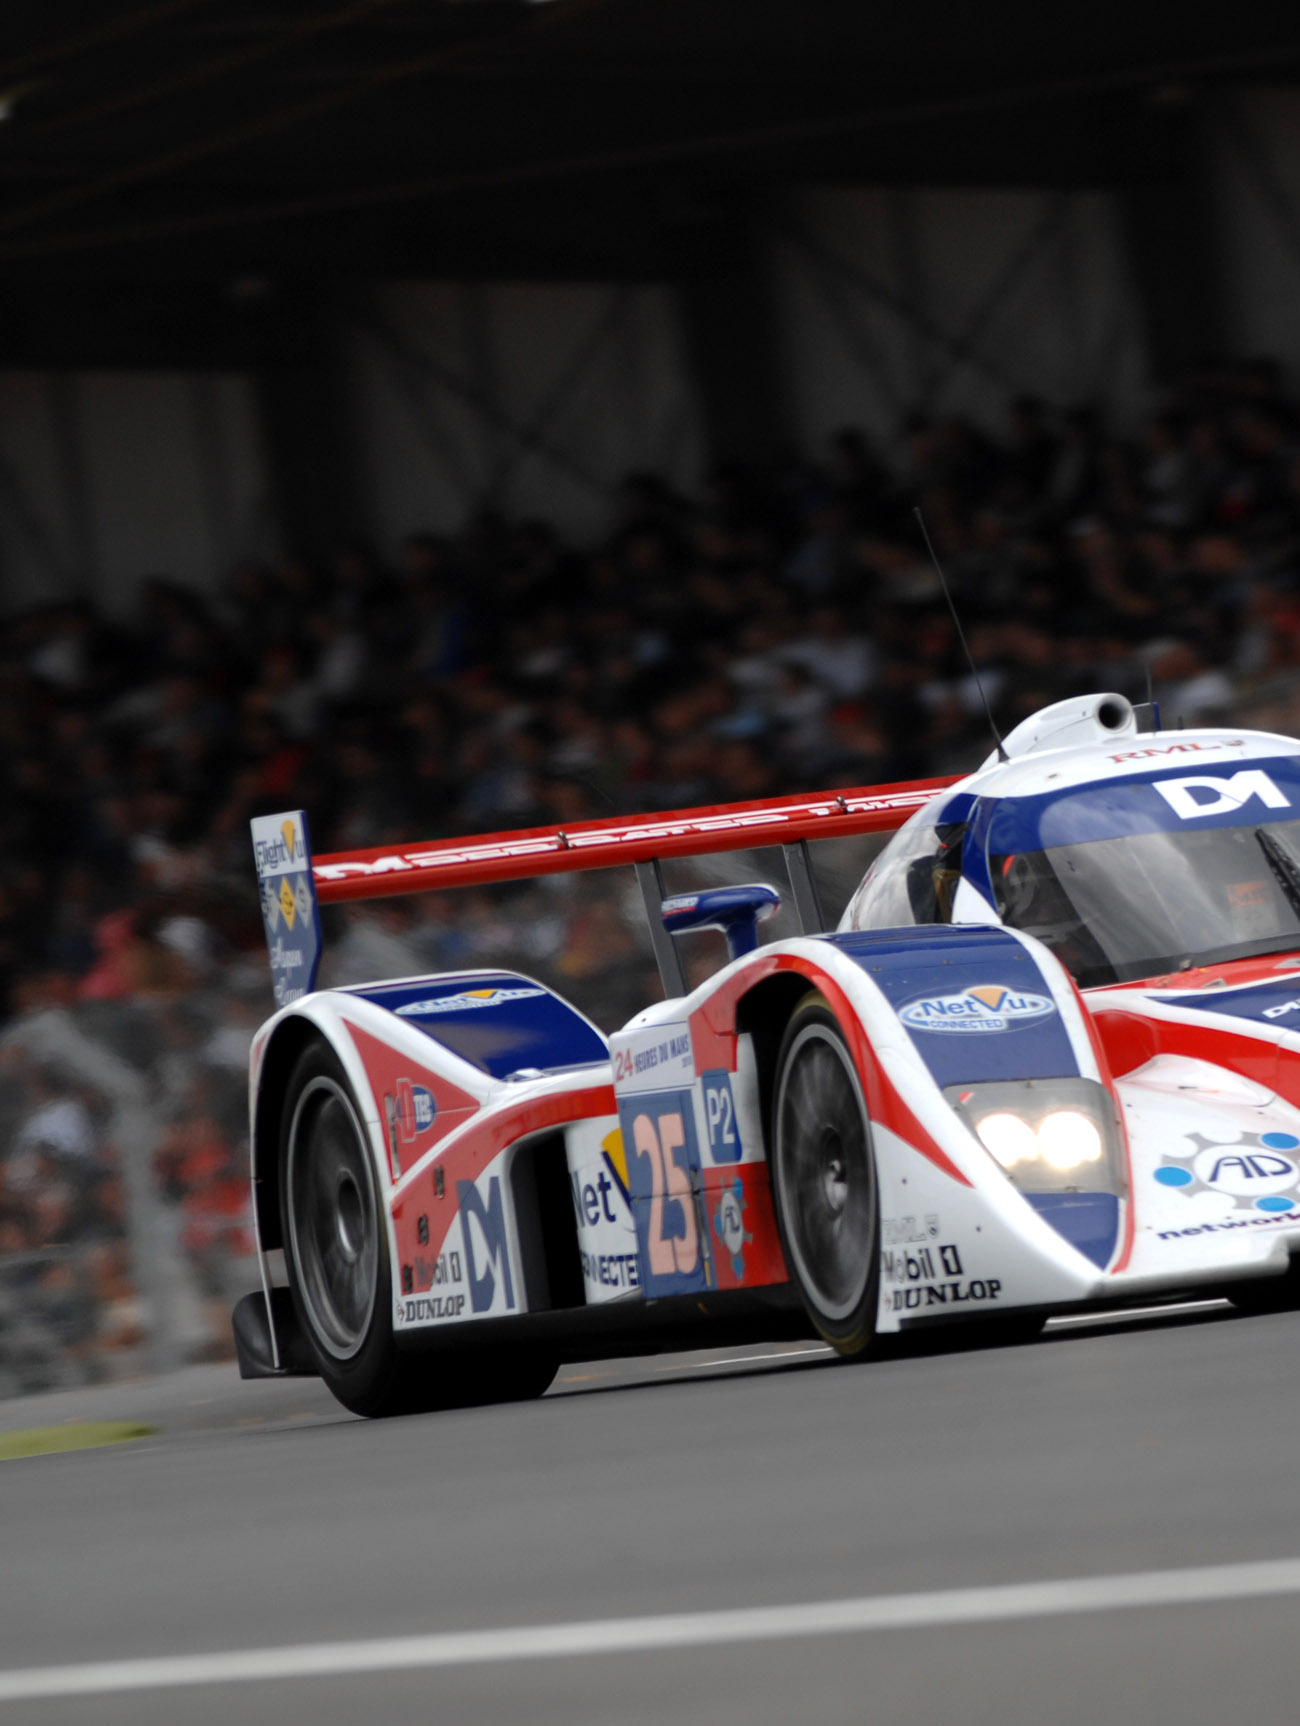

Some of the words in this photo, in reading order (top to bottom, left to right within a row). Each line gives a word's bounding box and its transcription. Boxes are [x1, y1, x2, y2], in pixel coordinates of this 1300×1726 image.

[1106, 743, 1222, 763] RML
[919, 990, 1027, 1016] NetVu
[929, 1018, 1004, 1029] CONNECTED
[615, 1047, 634, 1082] 24
[634, 1046, 659, 1074] HEURES
[658, 1041, 669, 1064] DU
[669, 1033, 690, 1059] MANS
[706, 1087, 736, 1146] P2
[1208, 1154, 1293, 1183] AD
[632, 1112, 698, 1276] 25
[938, 1244, 964, 1277] 1
[405, 1294, 465, 1323] DUNLOP
[892, 1279, 1002, 1311] DUNLOP
